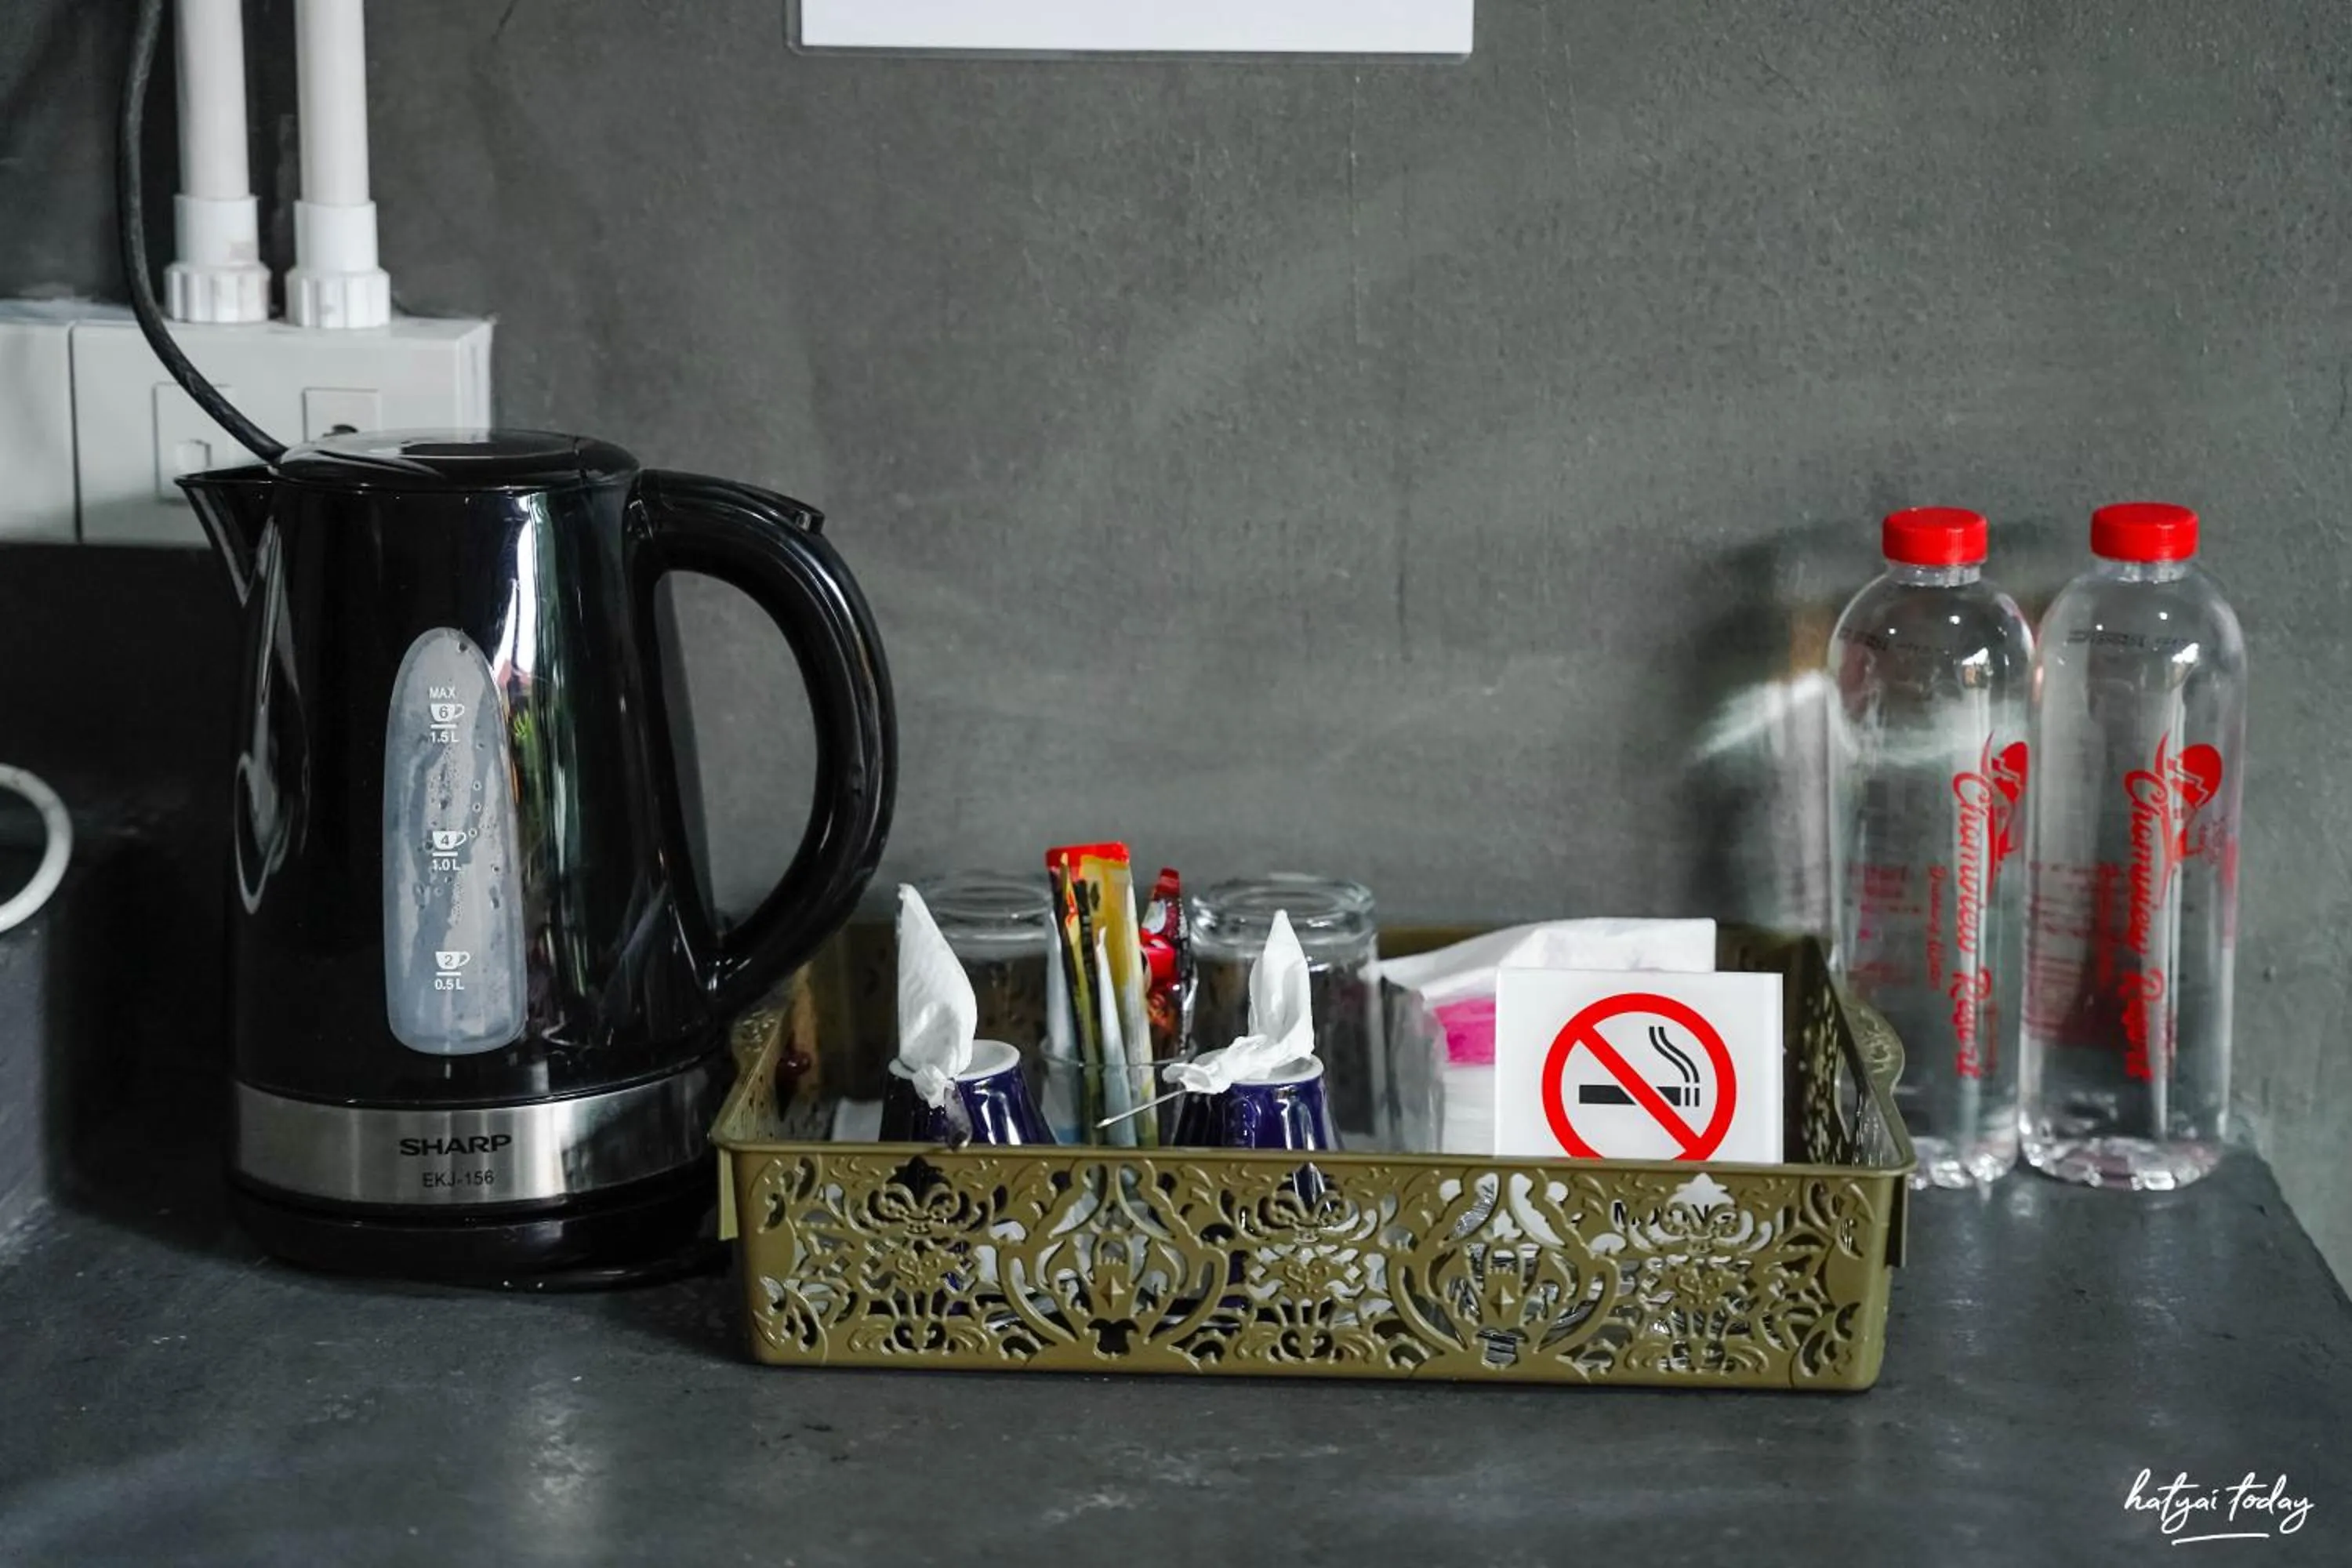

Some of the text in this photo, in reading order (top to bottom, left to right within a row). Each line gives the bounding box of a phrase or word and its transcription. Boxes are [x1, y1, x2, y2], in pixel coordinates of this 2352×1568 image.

[430, 686, 456, 699] MAX
[439, 705, 448, 719] 6
[440, 833, 449, 846] 4
[2120, 770, 2169, 1083] Chomview Resort
[445, 954, 453, 966] 2
[1950, 967, 1992, 1079] Resort
[399, 1134, 512, 1156] SHARP
[422, 1169, 495, 1188] EKJ-156
